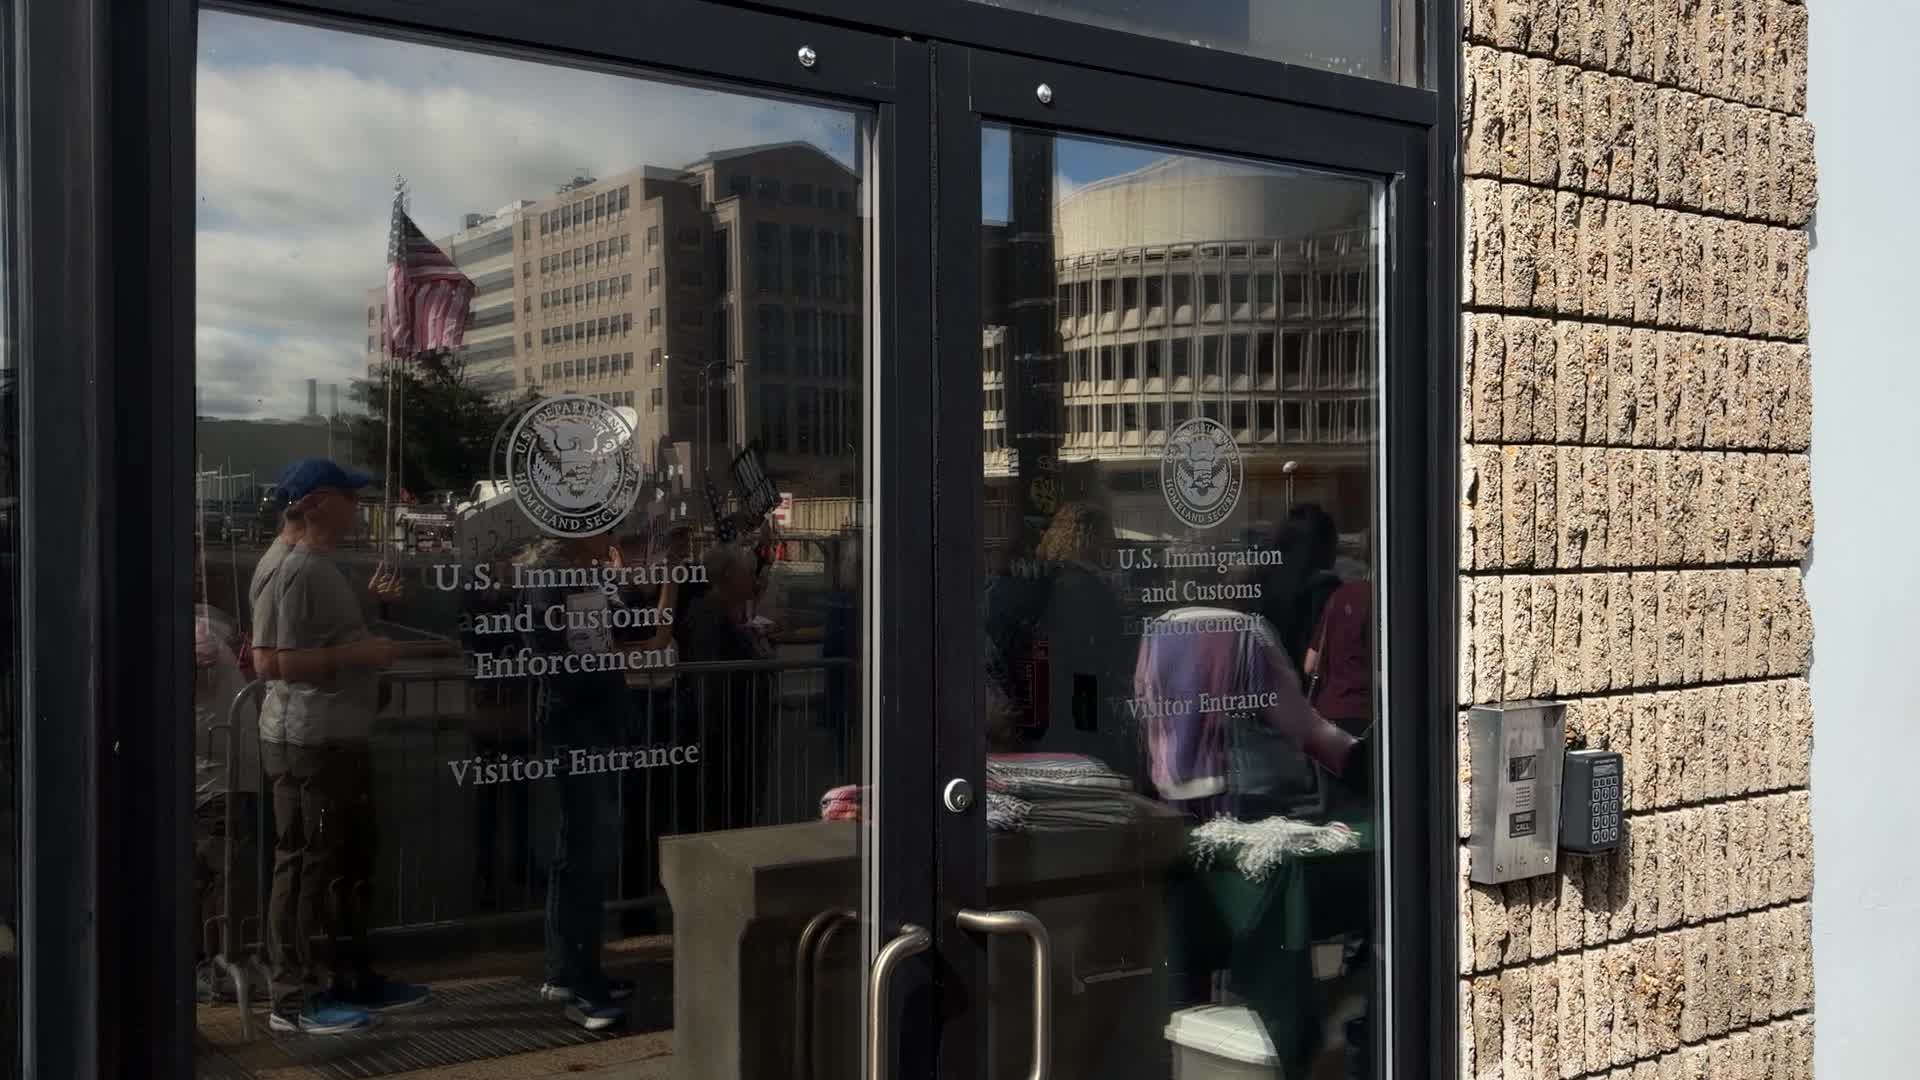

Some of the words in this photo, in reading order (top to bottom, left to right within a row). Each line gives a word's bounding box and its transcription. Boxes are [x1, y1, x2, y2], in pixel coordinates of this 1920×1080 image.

[513, 471, 580, 530] HOMELAND
[1165, 478, 1205, 524] HOMELAND
[1118, 548, 1158, 569] U.S.
[1164, 545, 1283, 574] Immigration
[433, 563, 500, 591] U.S.
[512, 558, 709, 595] Immigration
[1142, 581, 1177, 603] and
[1183, 580, 1262, 601] Customs
[474, 604, 535, 634] and
[544, 604, 675, 632] Customs
[1142, 612, 1264, 637] Enforcement
[473, 647, 676, 679] Enforcement
[1127, 696, 1192, 719] Visitor
[1198, 691, 1279, 713] Entrance
[448, 754, 559, 787] Visitor
[569, 744, 699, 775] Entrance
